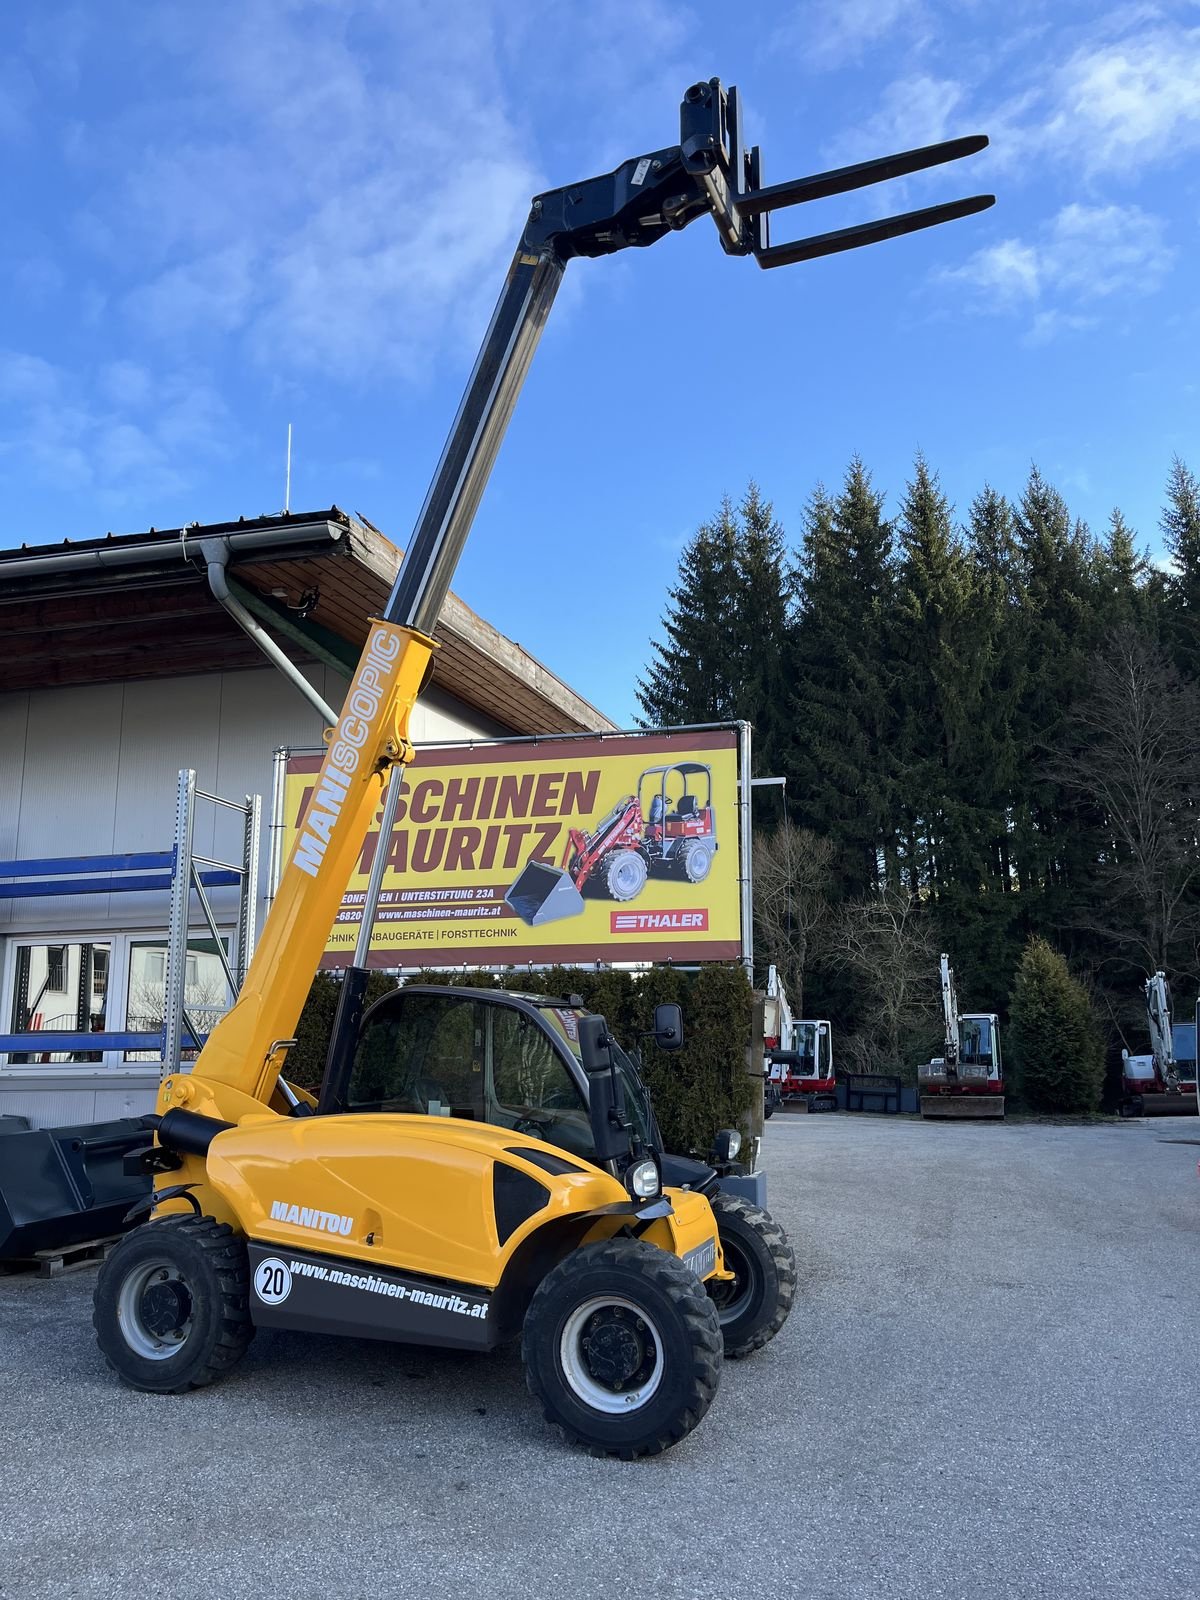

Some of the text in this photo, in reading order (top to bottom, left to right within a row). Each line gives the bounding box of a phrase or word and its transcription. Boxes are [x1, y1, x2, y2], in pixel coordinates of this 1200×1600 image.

[293, 629, 401, 878] MANISCOPIC
[401, 889, 474, 902] UNTERSTIFTUNG
[475, 888, 494, 899] 23A
[378, 906, 502, 920] www.maschinen-mauritz.at
[637, 913, 704, 928] THALER
[369, 929, 434, 942] NBAUGERÄTE
[441, 928, 518, 940] FORSTTECHNIK
[270, 1200, 354, 1236] MANITOU
[262, 1266, 284, 1296] 20
[290, 1261, 489, 1320] www.maschinen-mauritz.at
